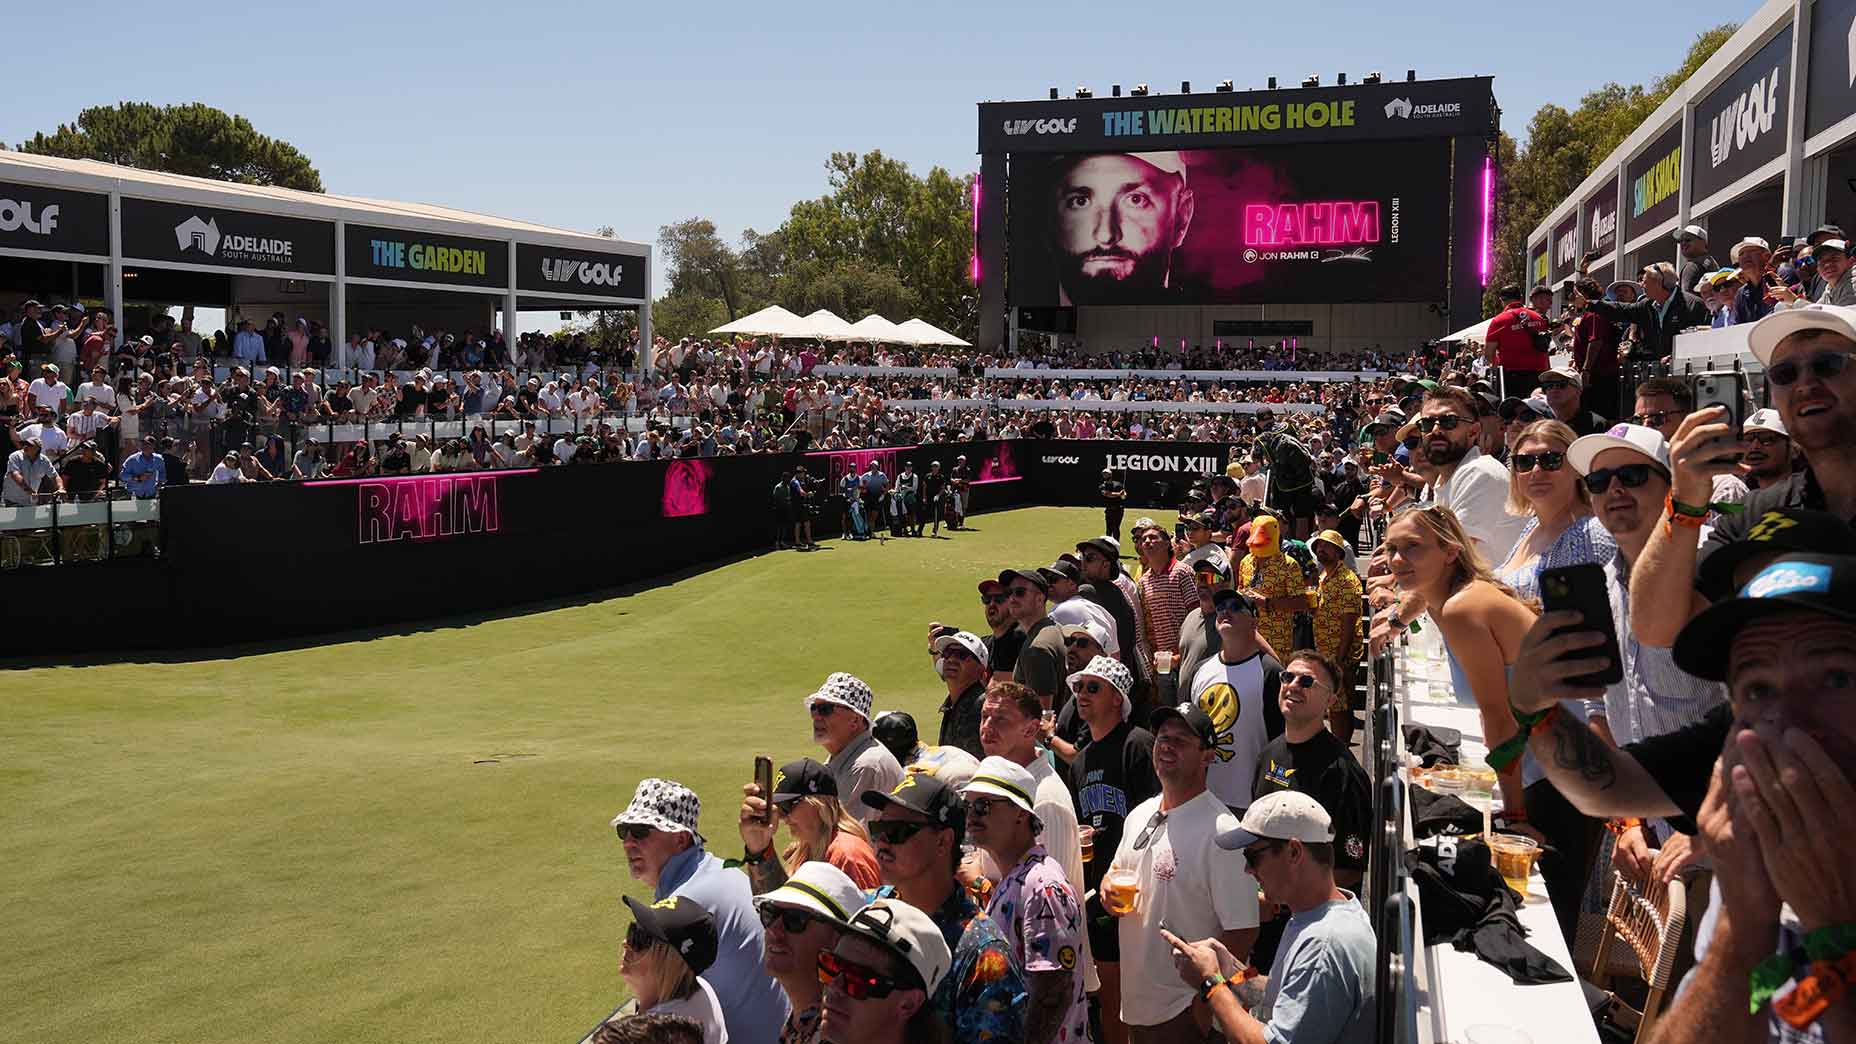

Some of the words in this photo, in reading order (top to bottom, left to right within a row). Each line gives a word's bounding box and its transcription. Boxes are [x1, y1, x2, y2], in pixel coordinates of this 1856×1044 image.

[1103, 111, 1143, 137] THE
[1149, 104, 1281, 135] WATERING
[1286, 100, 1355, 129] HOLE
[1413, 103, 1460, 114] ADELAIDE
[1245, 201, 1379, 245] RAHM
[1391, 213, 1399, 243] LEGION
[222, 235, 292, 256] ADELAIDE
[222, 250, 249, 259] SOUTH
[252, 253, 292, 264] AUSTRALIA
[370, 239, 405, 268] THE
[408, 244, 486, 275] GARDEN
[1259, 251, 1278, 261] JON
[1280, 251, 1309, 260] RAHM
[1105, 454, 1179, 472] LEGION
[1184, 456, 1217, 473] XIII
[359, 477, 498, 544] RAHM
